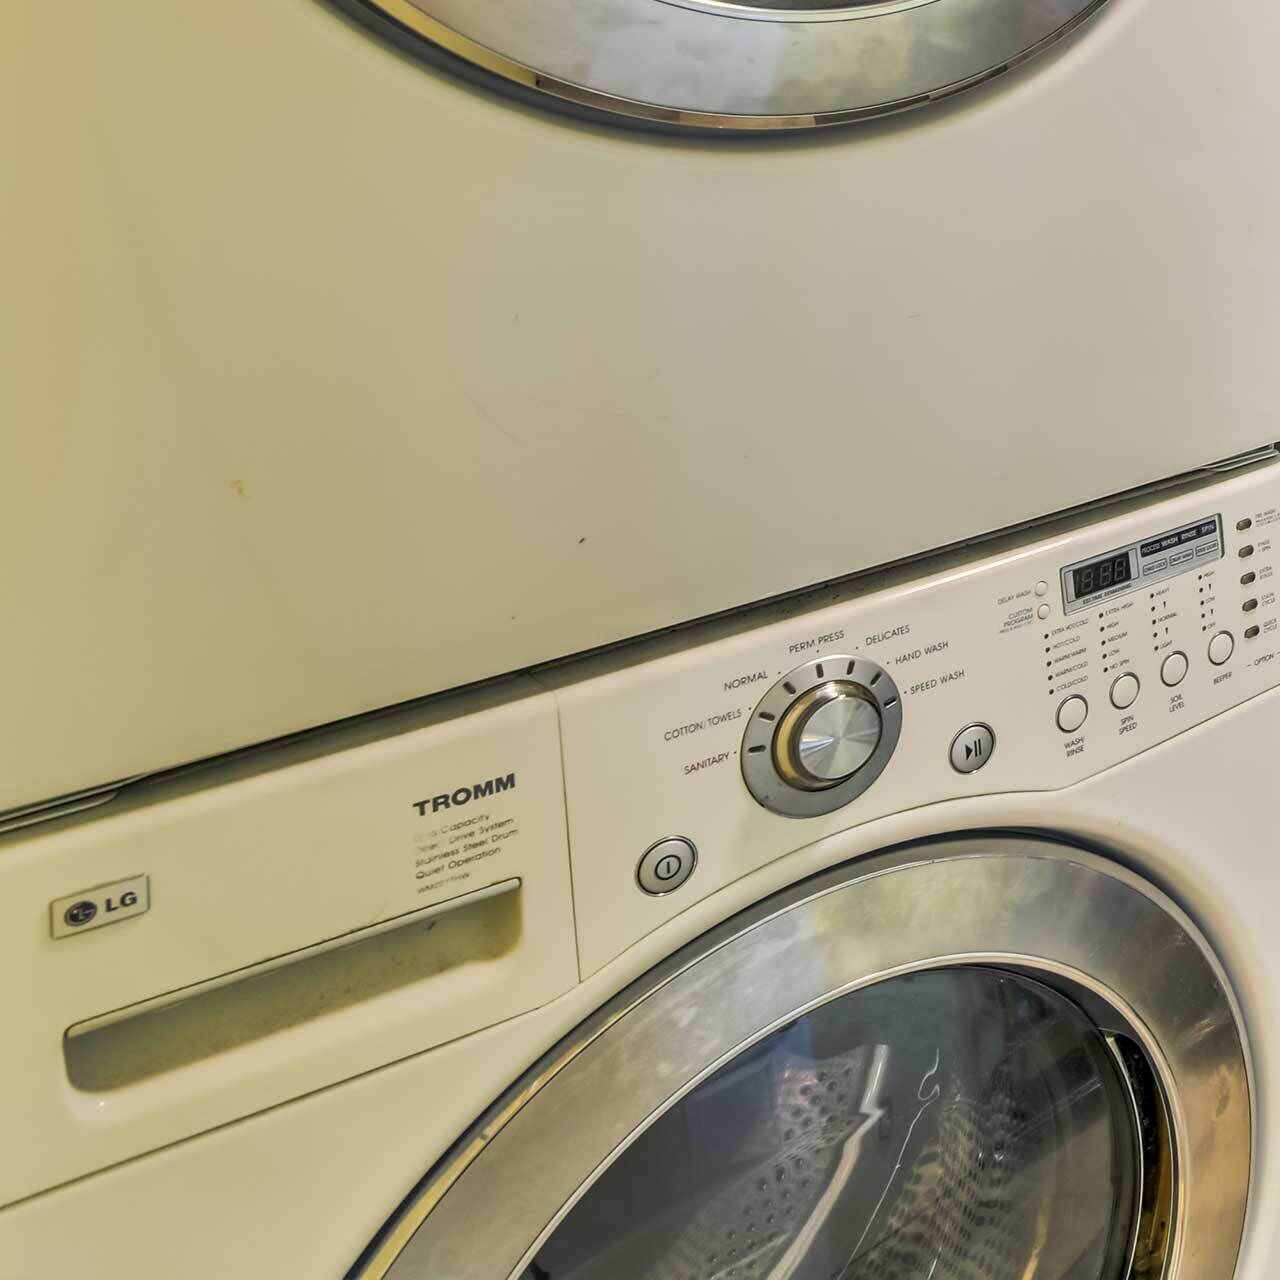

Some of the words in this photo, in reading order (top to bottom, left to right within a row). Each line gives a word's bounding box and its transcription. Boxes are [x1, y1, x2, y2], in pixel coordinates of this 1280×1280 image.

[789, 641, 815, 654] PERM
[818, 631, 844, 647] PRESS
[866, 625, 910, 646] DELICATES
[895, 650, 921, 664] HAND
[924, 641, 949, 656] WASH
[1254, 653, 1274, 666] OPTION
[724, 671, 769, 690] NORMAL
[910, 679, 937, 694] SPEED
[940, 670, 965, 686] WASH
[684, 752, 729, 774] SANITARY
[413, 773, 515, 816] TROMM
[448, 847, 501, 869] Operation
[104, 891, 137, 914] LG
